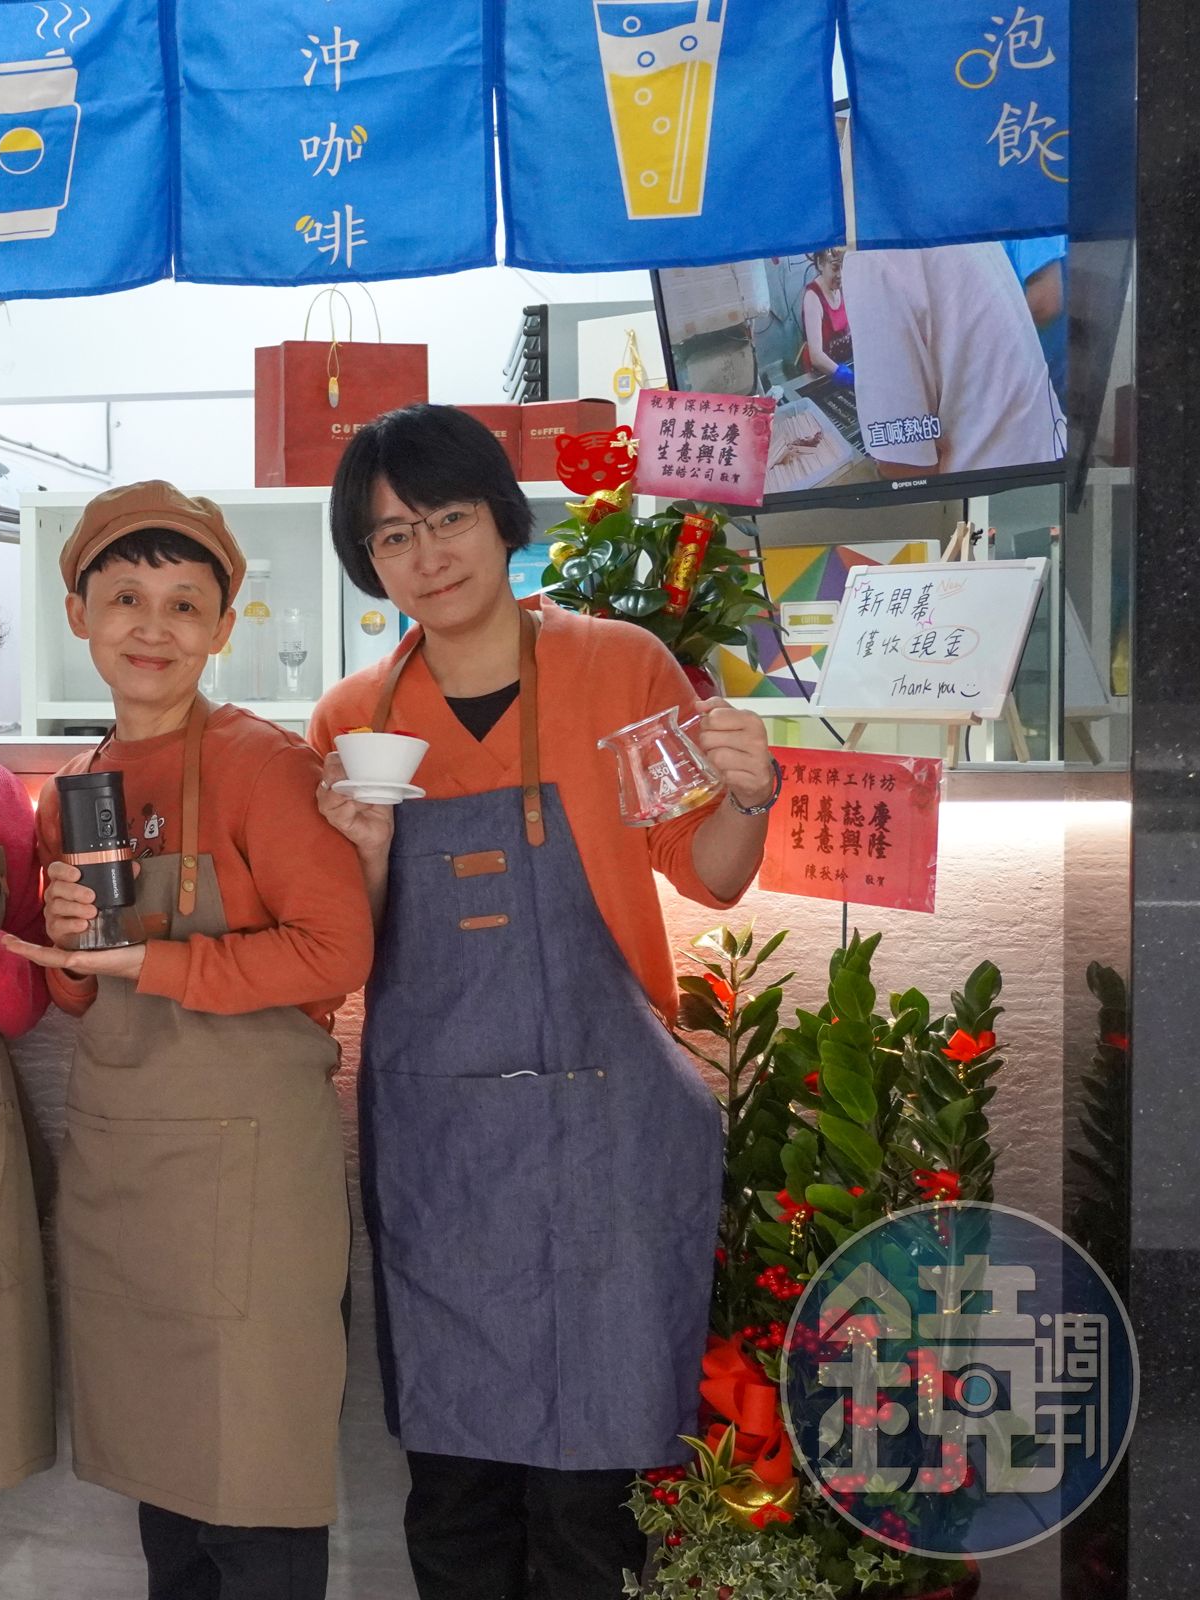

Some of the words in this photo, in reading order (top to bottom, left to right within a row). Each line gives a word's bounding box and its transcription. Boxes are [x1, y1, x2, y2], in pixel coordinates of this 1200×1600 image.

[983, 6, 1065, 168] 泡飲
[659, 418, 741, 446] 開幕誌慶
[868, 415, 941, 447] 直喊熱的
[657, 440, 738, 467] 生意興隆
[857, 584, 934, 621] 新開幕
[857, 628, 966, 658] 僅收現金
[891, 674, 932, 696] Thank
[937, 681, 956, 698] you
[790, 794, 892, 833] 開幕誌慶
[790, 823, 893, 860] 生意興隆
